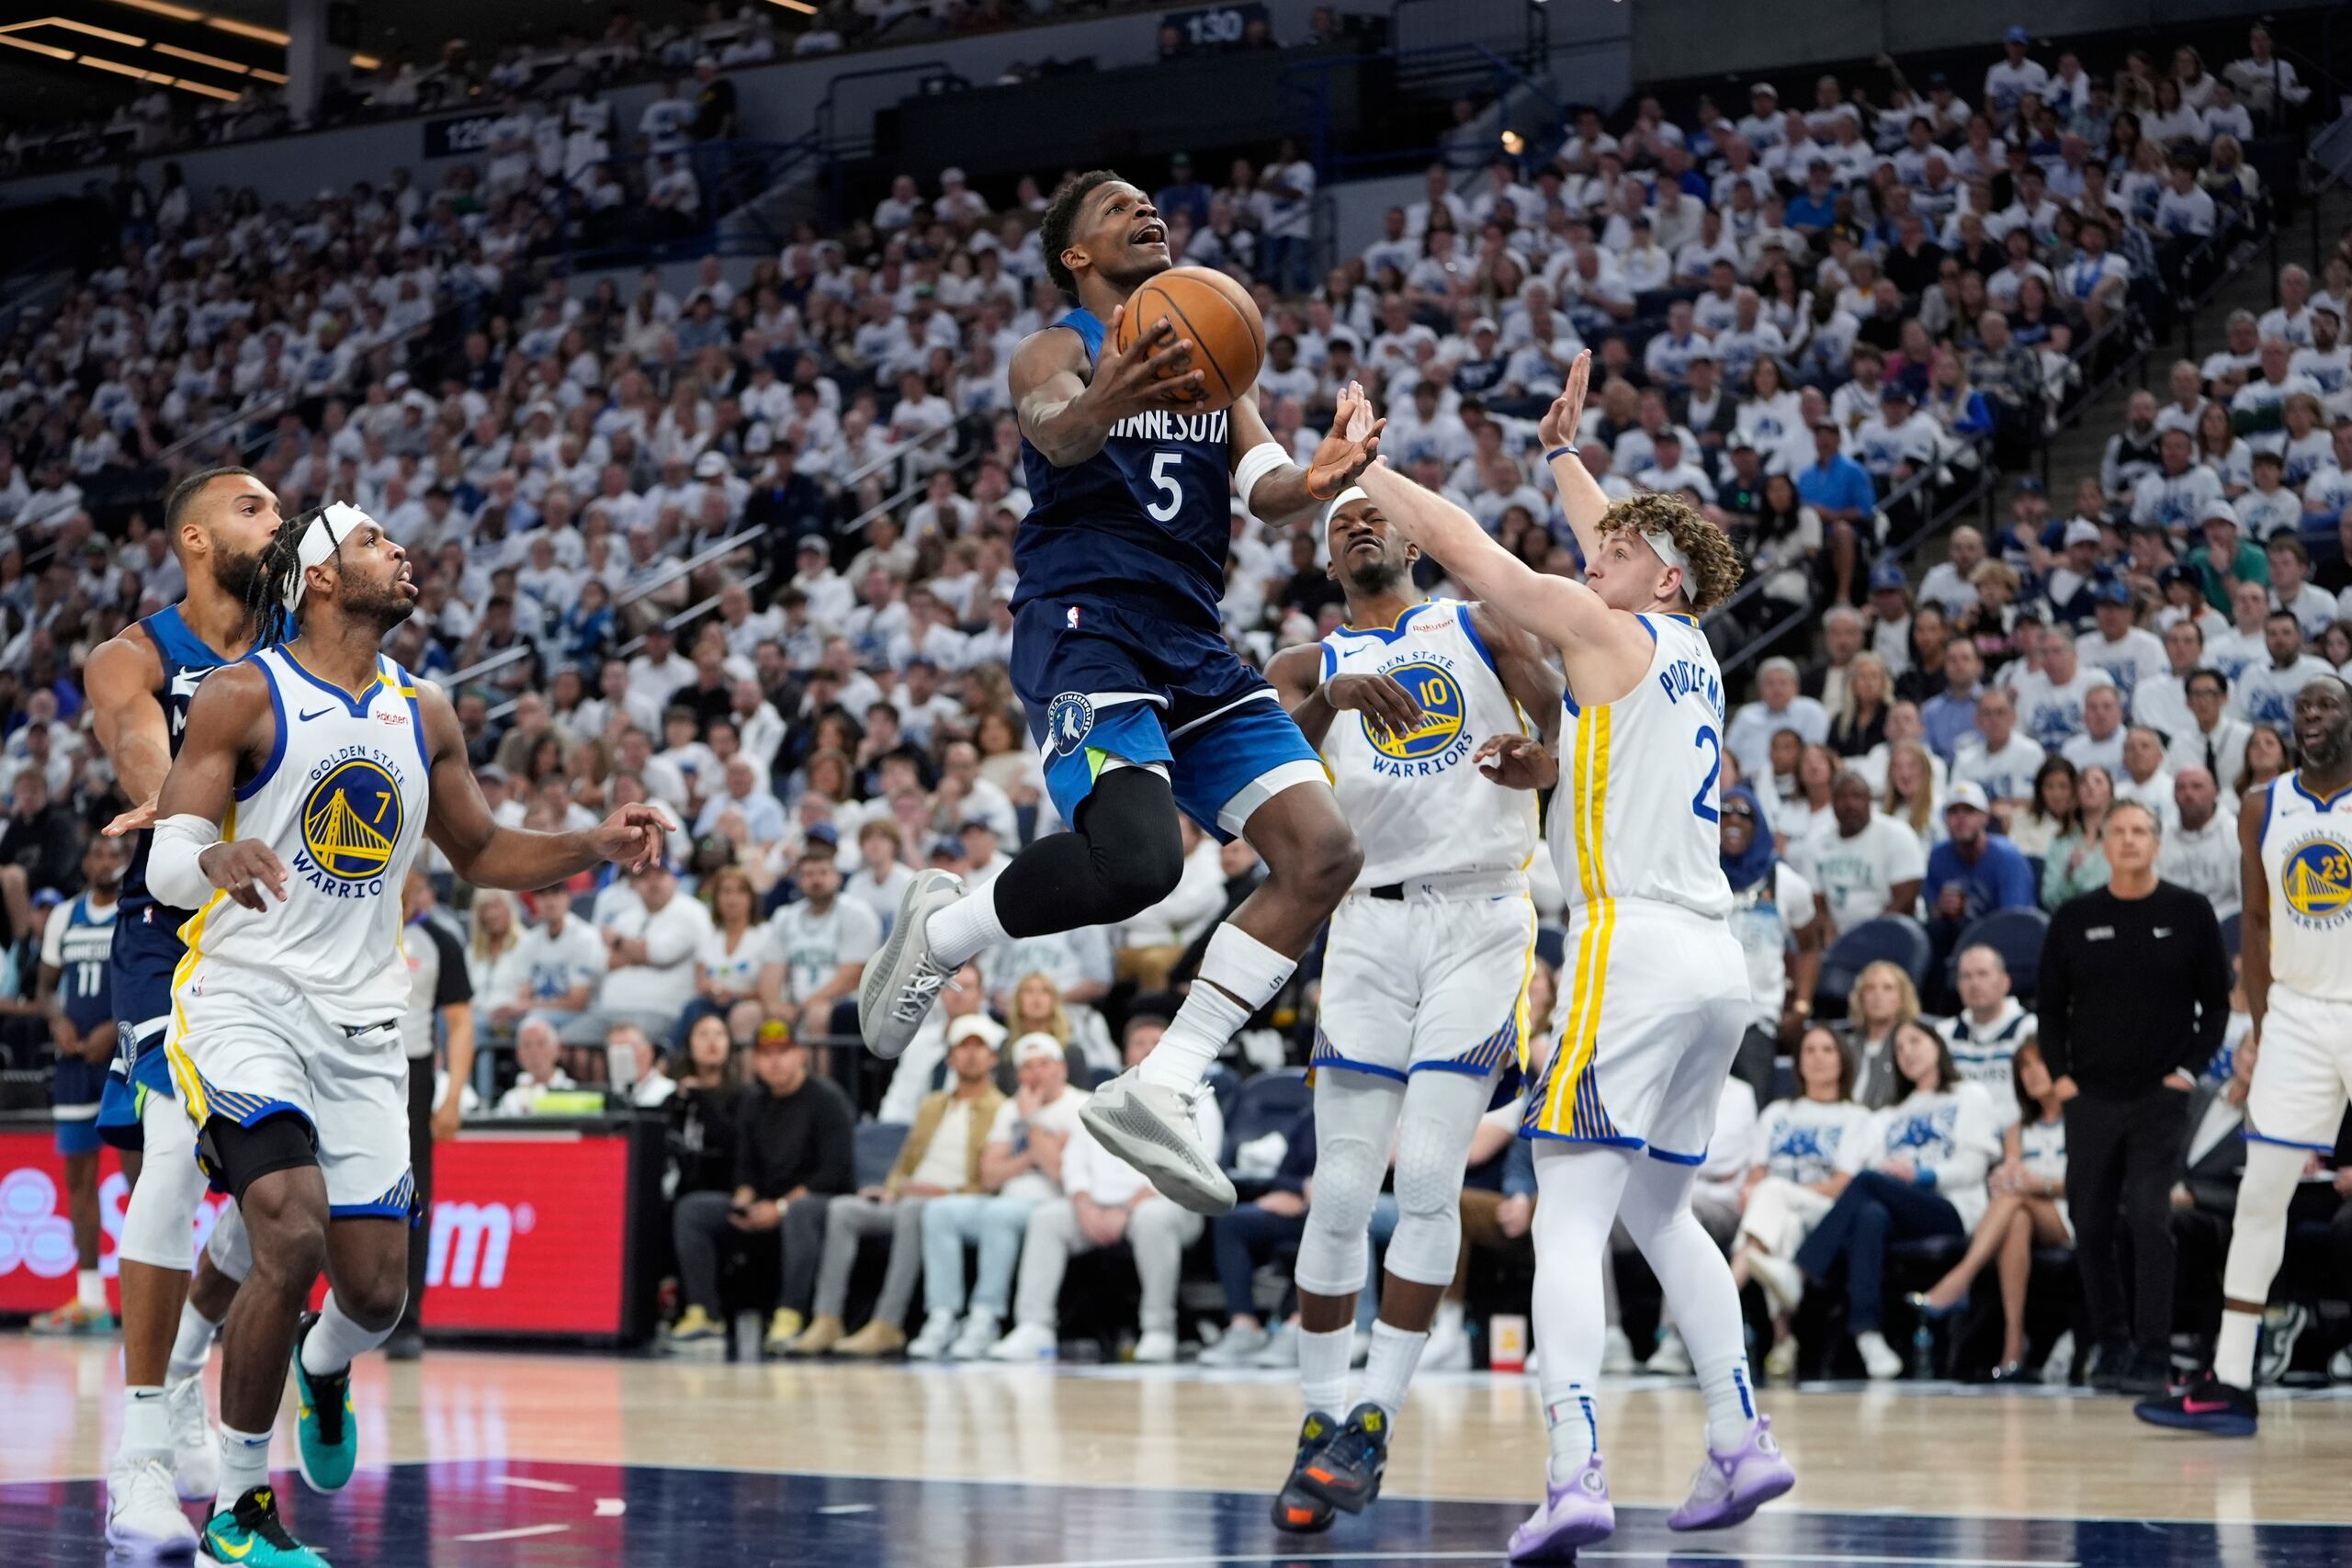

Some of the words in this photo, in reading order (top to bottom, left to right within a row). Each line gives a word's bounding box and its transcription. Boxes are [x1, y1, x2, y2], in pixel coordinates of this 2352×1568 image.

[1186, 9, 1243, 43] 130
[1147, 453, 1182, 522] 5
[1412, 618, 1454, 632] Rakuten
[1376, 654, 1405, 673] DEN
[1412, 651, 1454, 670] STATE
[1419, 678, 1448, 707] 10
[377, 710, 409, 726] Rakuten
[1060, 694, 1091, 731] TIMBERWOLVES
[311, 745, 366, 781] GOLDEN
[373, 750, 405, 787] STATE
[1373, 730, 1473, 778] WARRIORS
[1692, 725, 1720, 824] 2
[374, 792, 391, 824] 7
[292, 849, 382, 898] WARRIO
[2321, 855, 2348, 881] 23
[77, 962, 102, 998] 11
[1269, 976, 1283, 989] 5
